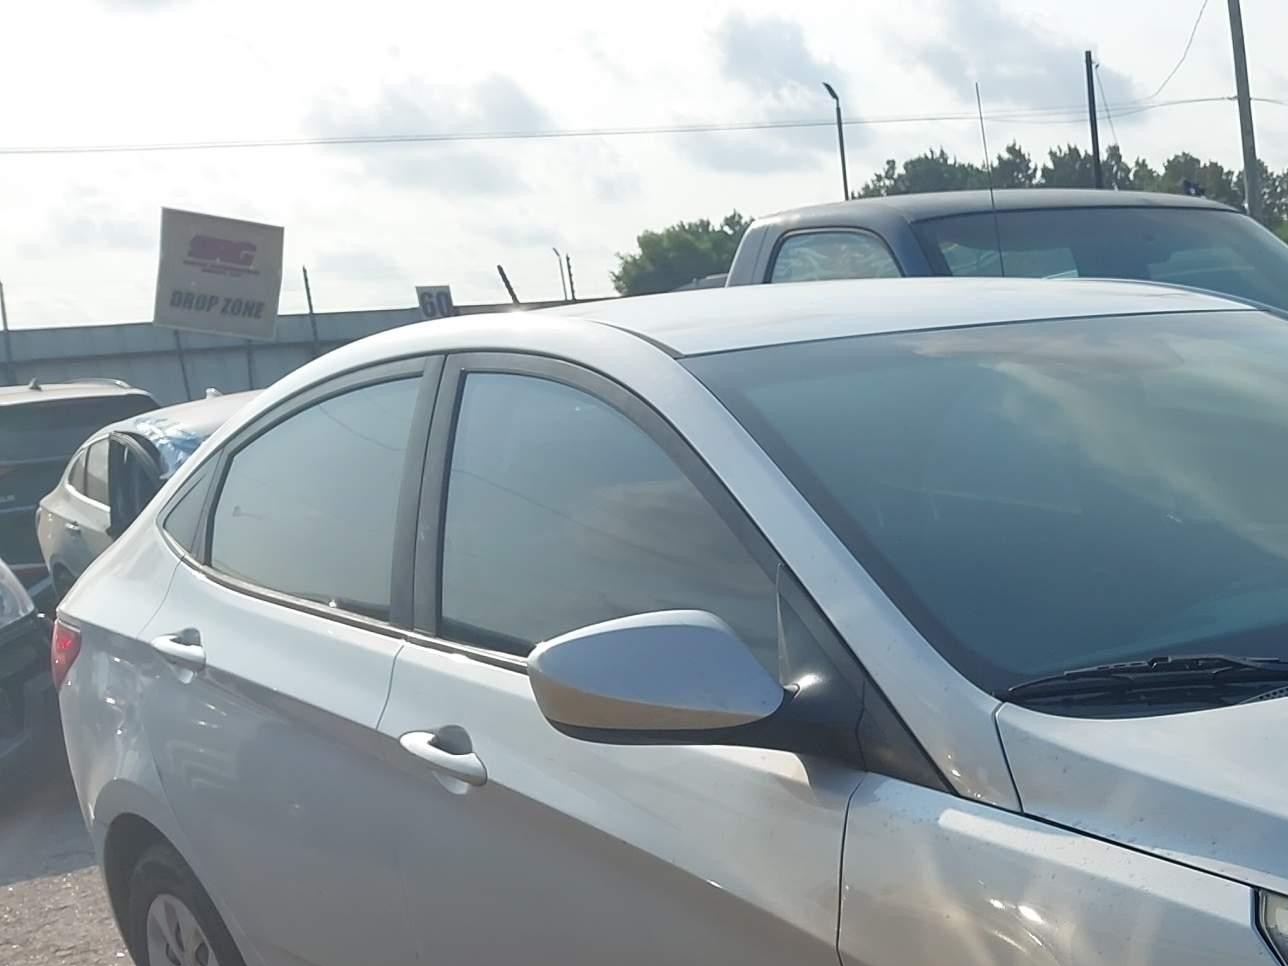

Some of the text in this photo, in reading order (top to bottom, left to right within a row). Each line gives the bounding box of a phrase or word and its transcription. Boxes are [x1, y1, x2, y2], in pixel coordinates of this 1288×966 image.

[169, 289, 265, 319] DROP ZONE
[420, 291, 450, 318] 60
